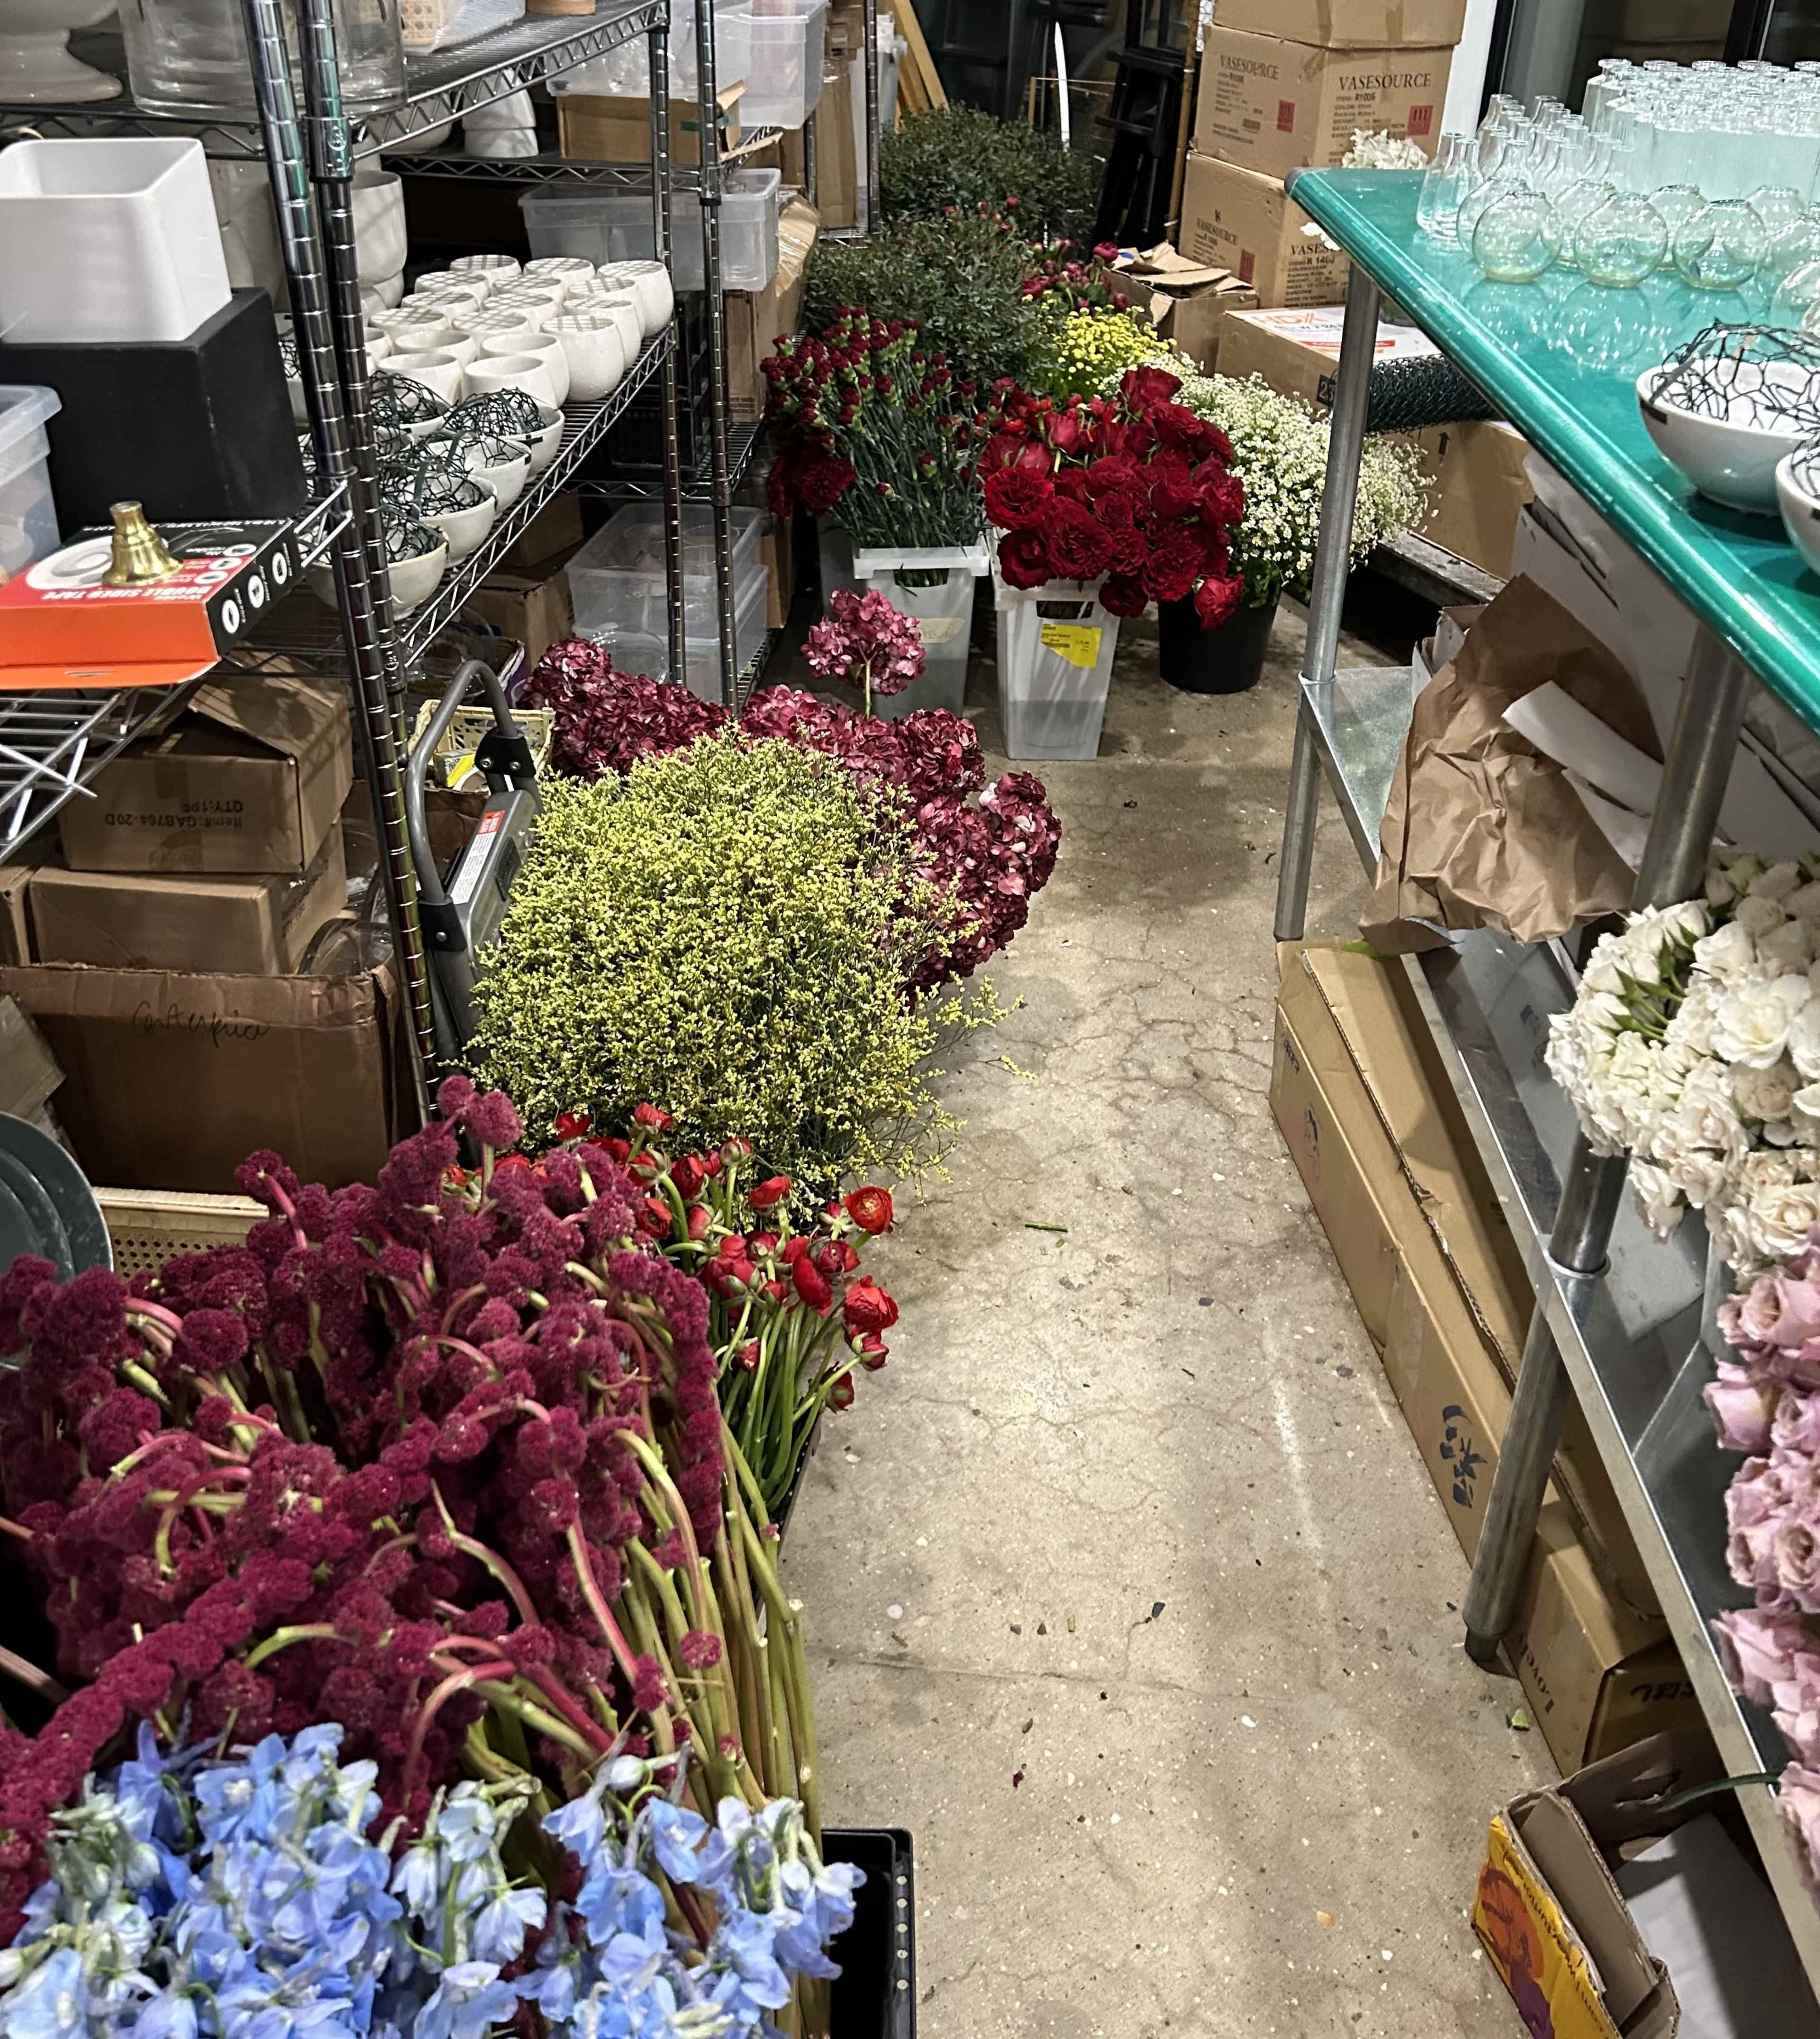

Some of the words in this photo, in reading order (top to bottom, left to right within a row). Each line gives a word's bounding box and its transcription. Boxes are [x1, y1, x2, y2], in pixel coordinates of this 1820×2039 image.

[1220, 55, 1279, 80] VASESOURCE
[1339, 73, 1431, 91] VASESOURCE
[42, 591, 87, 600] TAPE
[87, 589, 143, 598] SIDED
[147, 586, 213, 597] DOUBLE
